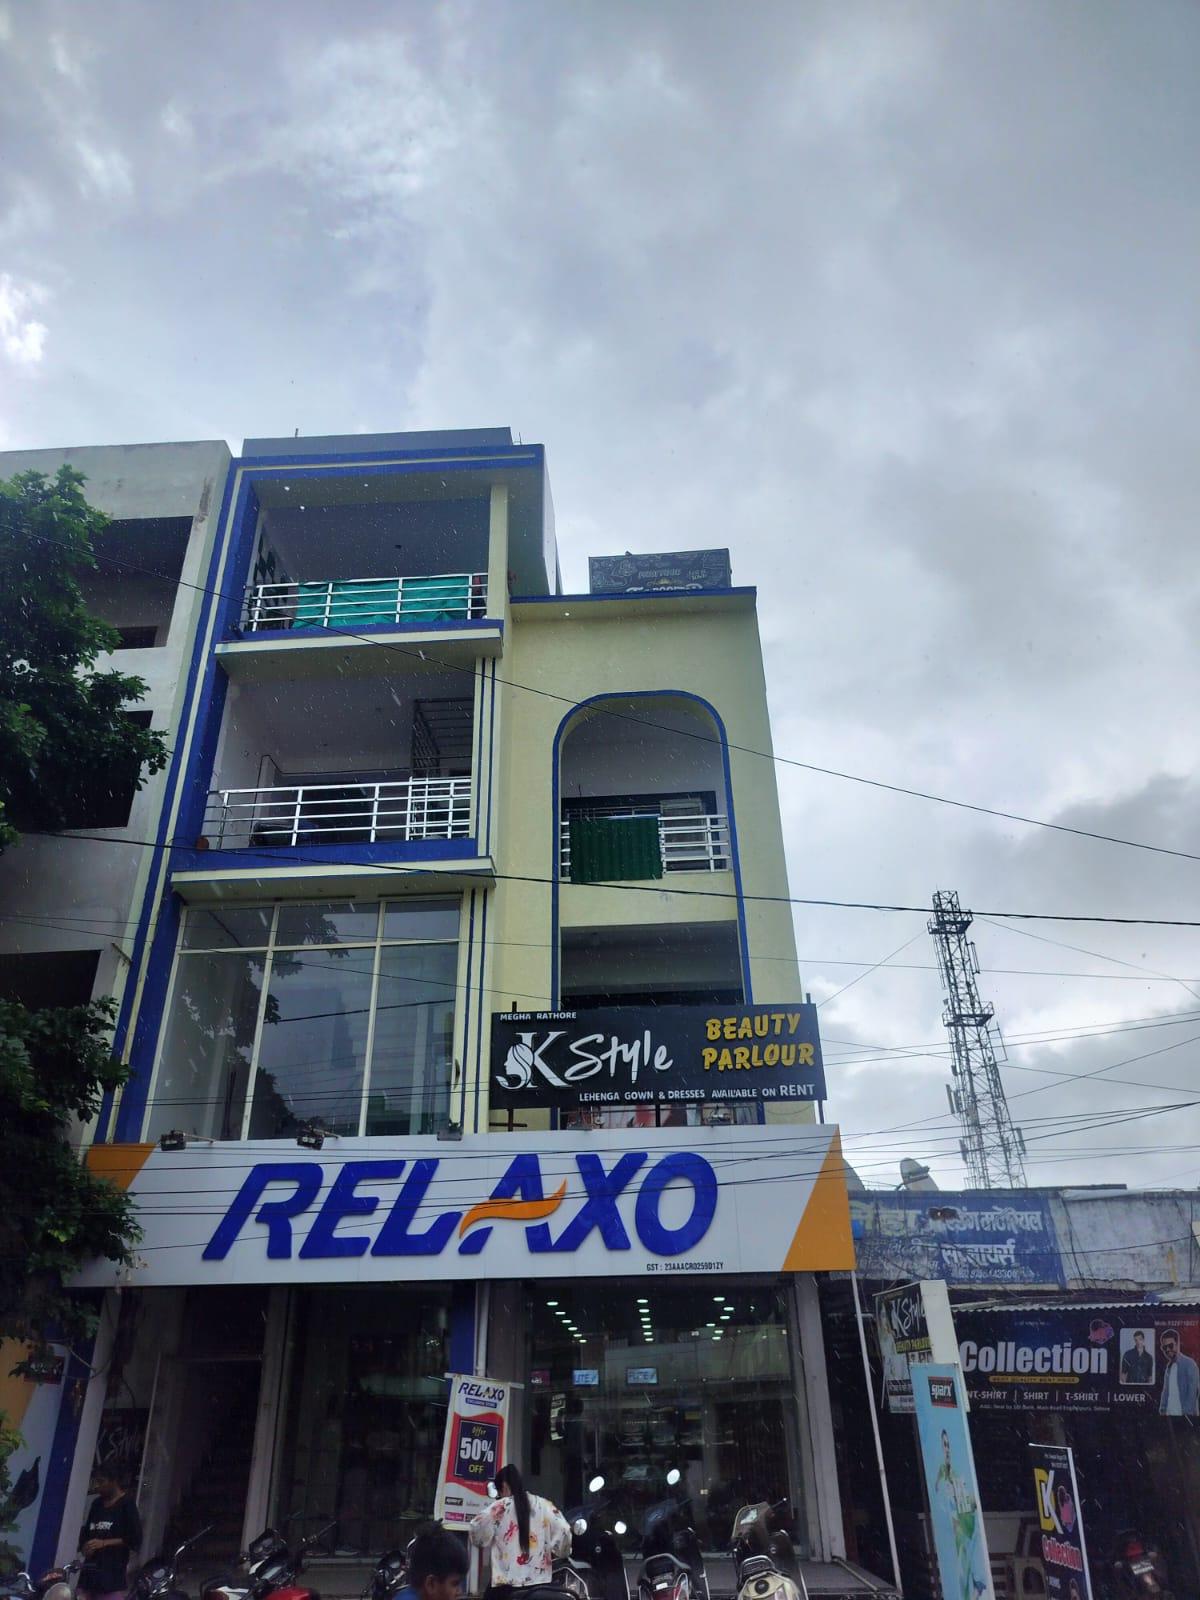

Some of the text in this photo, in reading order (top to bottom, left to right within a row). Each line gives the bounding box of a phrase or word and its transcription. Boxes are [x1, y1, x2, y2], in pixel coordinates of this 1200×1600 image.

[500, 1012, 577, 1021] MEGHA RATHORE
[706, 1013, 801, 1041] BEAUTY
[564, 1030, 673, 1084] Style
[703, 1043, 815, 1071] PARLOUR
[579, 1083, 815, 1102] LEHENGA GOWN & DRESSES AVAILABLE ON RENT
[202, 1151, 717, 1259] RELAXO
[960, 1340, 1108, 1375] Collection
[458, 1382, 504, 1402] RELAXO
[1023, 1391, 1049, 1400] SHIRT
[1065, 1392, 1099, 1402] T-SHIRT
[1113, 1393, 1146, 1402] LOWER
[459, 1437, 494, 1463] 50%
[468, 1464, 485, 1474] OFF
[1041, 1533, 1083, 1572] Collection
